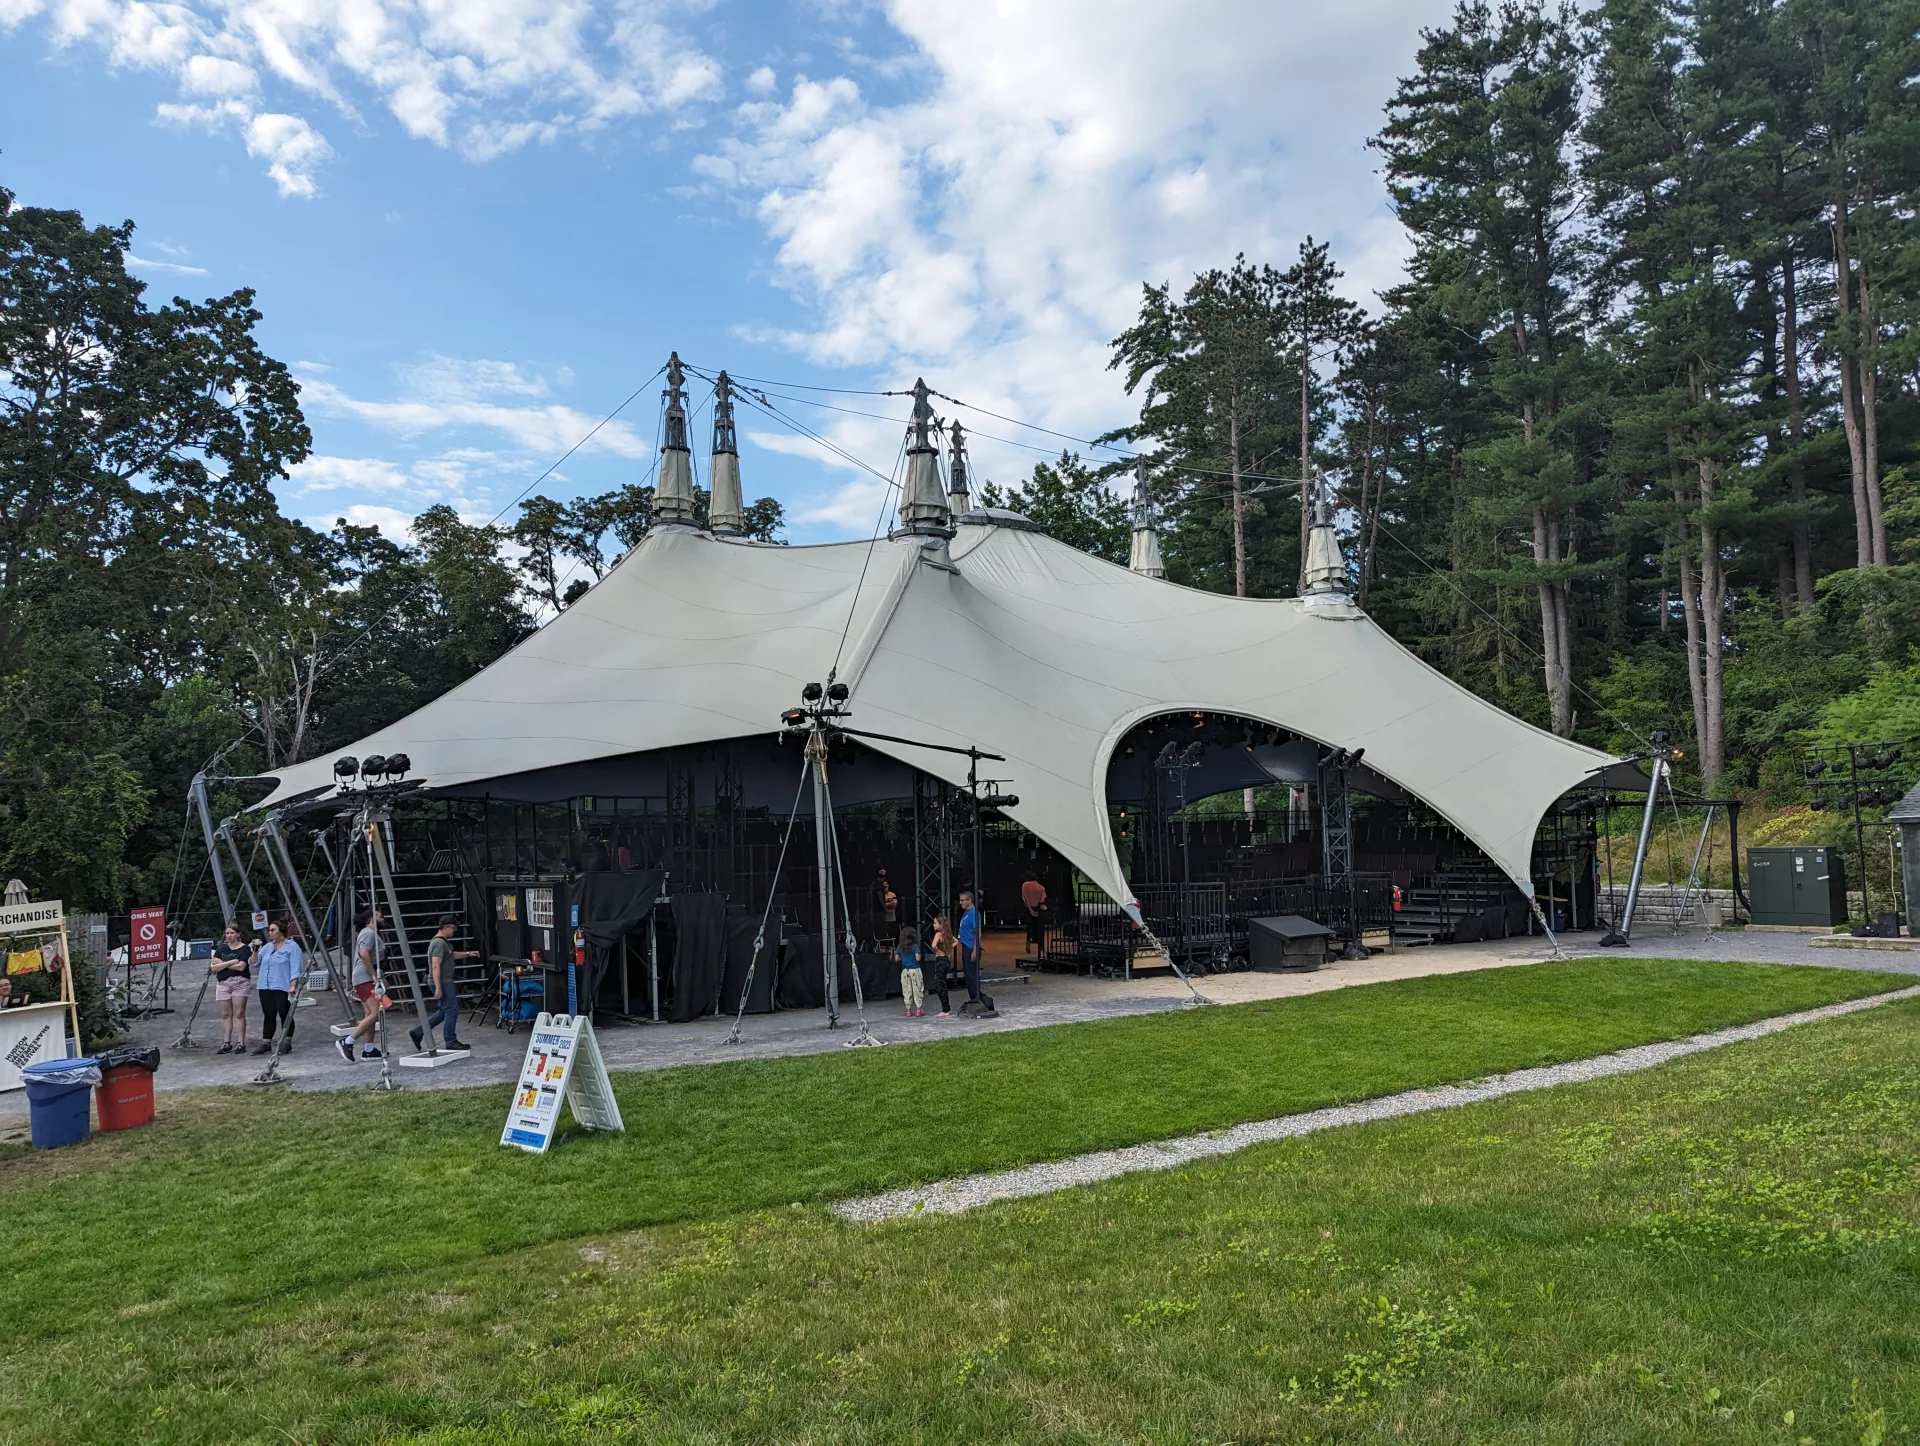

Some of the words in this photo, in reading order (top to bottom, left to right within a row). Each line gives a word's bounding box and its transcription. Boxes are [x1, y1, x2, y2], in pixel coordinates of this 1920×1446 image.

[131, 912, 147, 920] ONE
[136, 951, 160, 960] ENTER
[147, 943, 161, 951] NOT
[5, 1035, 28, 1061] HUDSON
[13, 1024, 51, 1067] SHAKESPEARE
[535, 1033, 560, 1045] SUMMER
[558, 1039, 572, 1050] 2023
[9, 1041, 29, 1063] VALLEY
[17, 1043, 42, 1069] FESTIVAL
